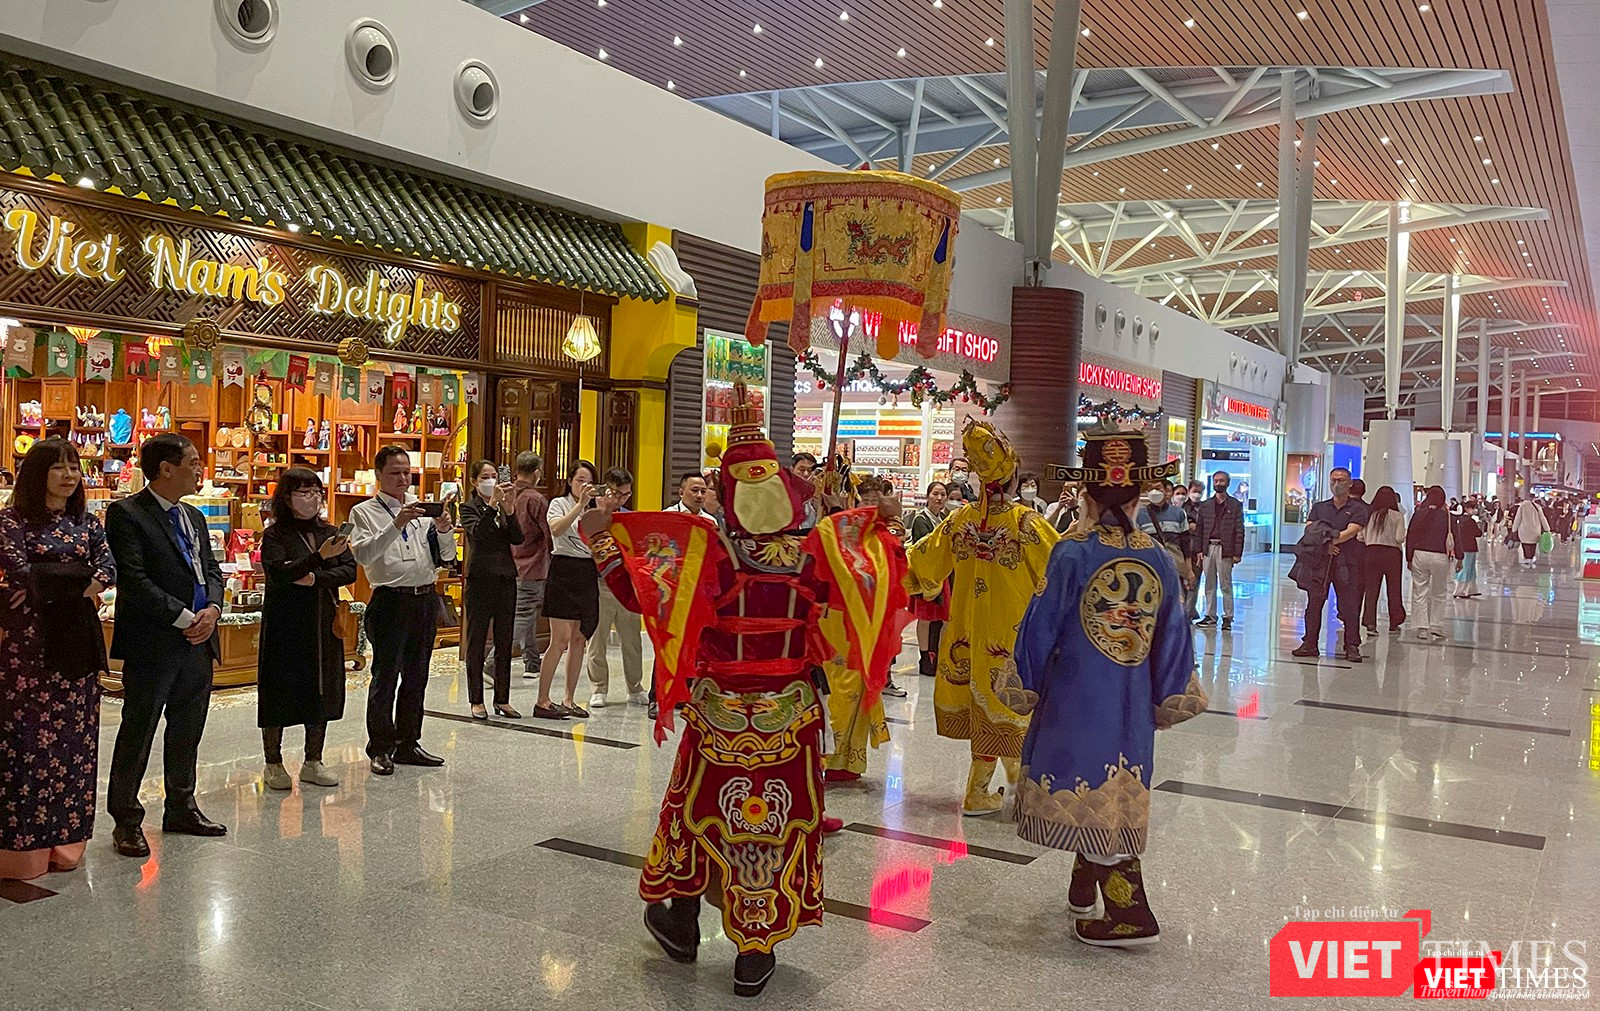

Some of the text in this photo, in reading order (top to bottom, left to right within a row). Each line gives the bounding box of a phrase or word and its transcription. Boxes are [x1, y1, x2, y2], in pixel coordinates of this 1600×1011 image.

[3, 209, 462, 343] Viet Nam's Delights
[964, 331, 998, 362] SHOP
[1078, 362, 1162, 399] UCKY SOUVENIR SHOP
